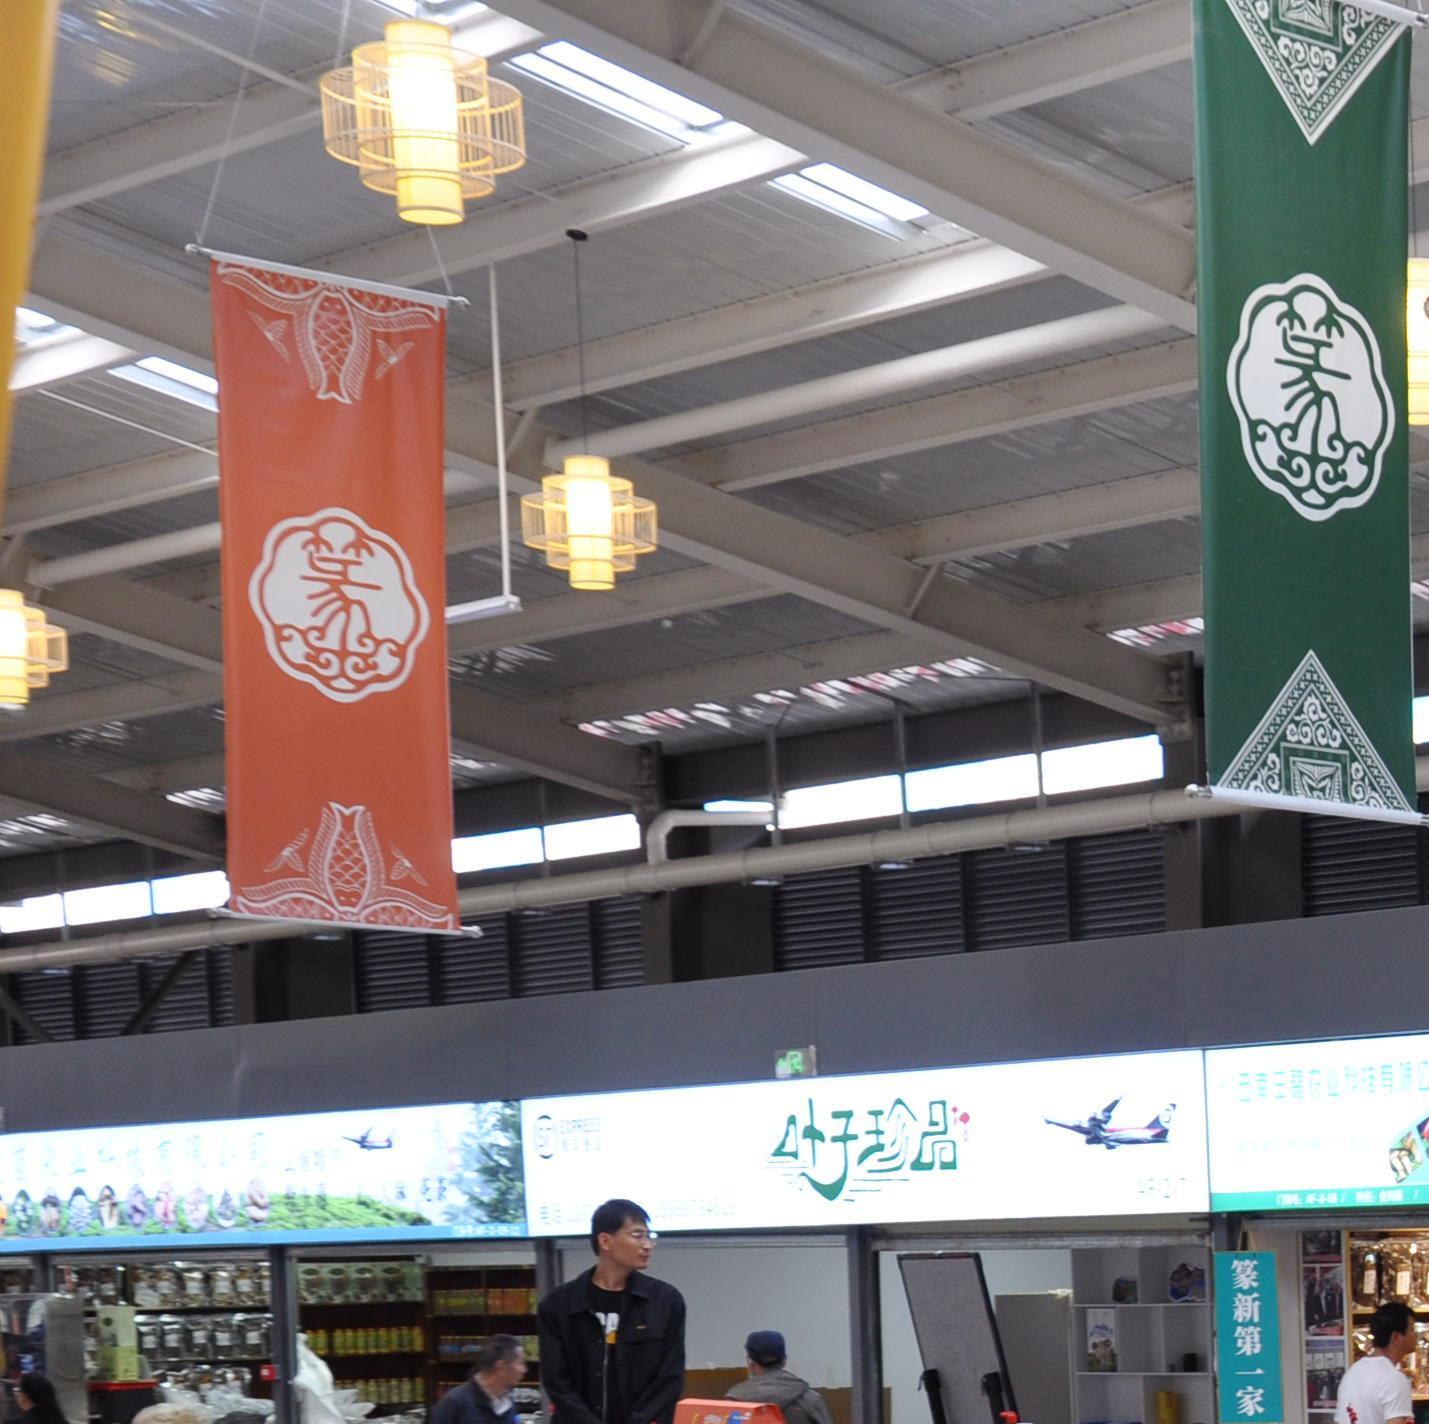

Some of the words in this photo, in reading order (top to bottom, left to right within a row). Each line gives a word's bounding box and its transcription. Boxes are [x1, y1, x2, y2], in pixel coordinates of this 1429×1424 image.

[1230, 1258, 1265, 1417] 篆新第一家
